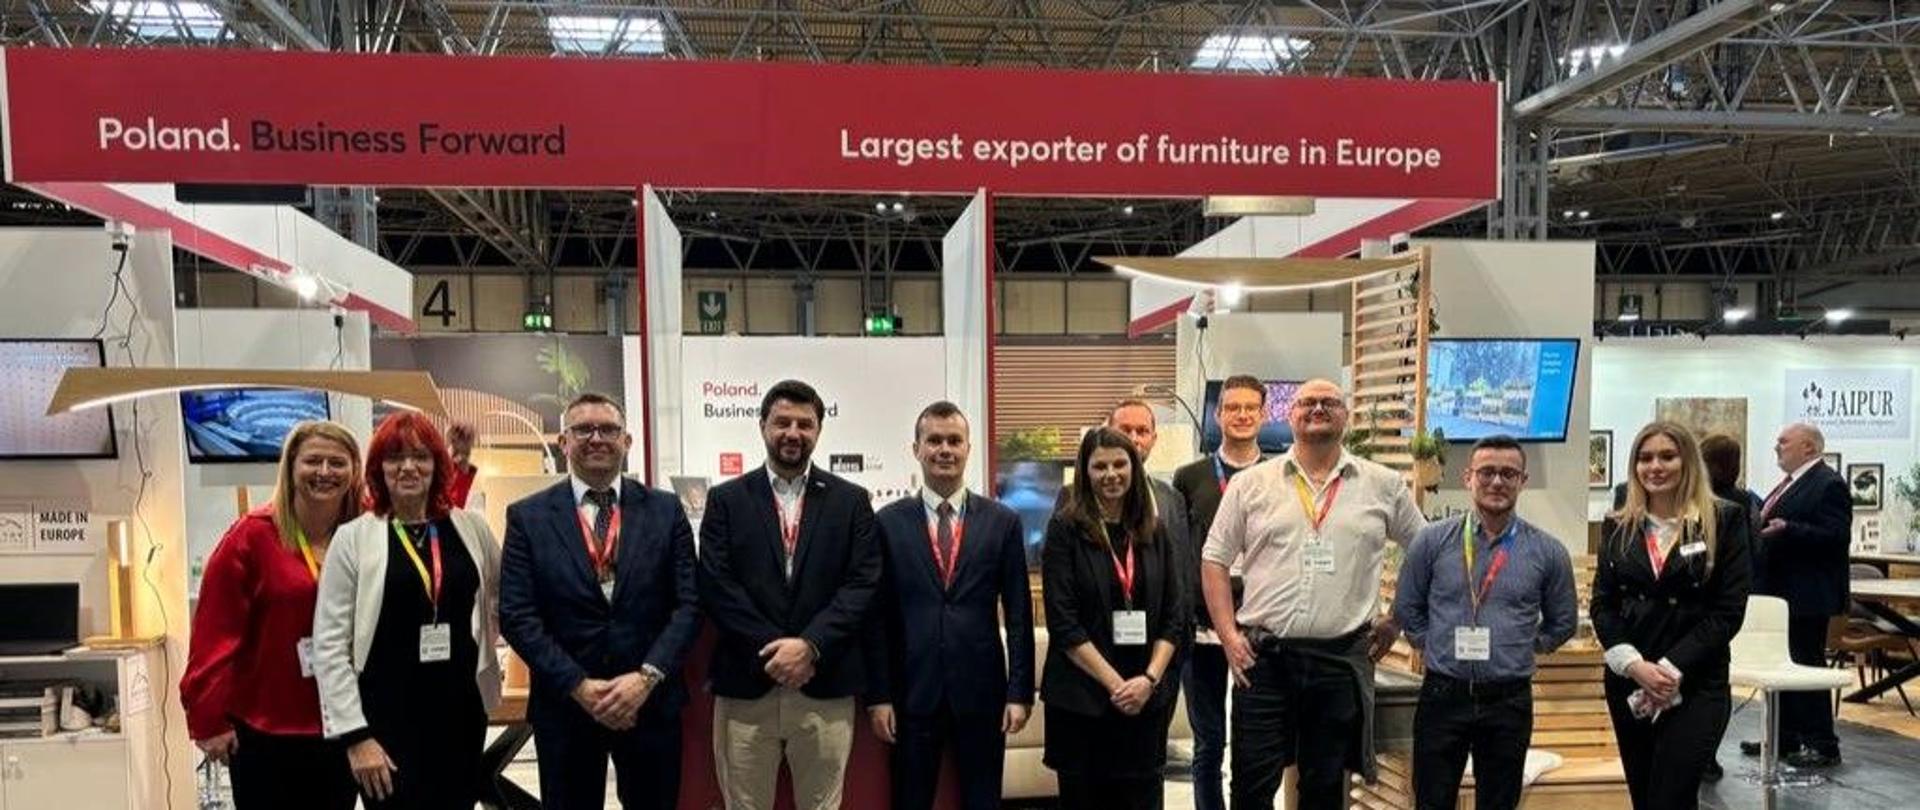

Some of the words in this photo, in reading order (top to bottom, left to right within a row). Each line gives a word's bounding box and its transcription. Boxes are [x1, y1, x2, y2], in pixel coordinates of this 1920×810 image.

[99, 117, 241, 151] Poland.
[250, 119, 407, 154] Business
[418, 122, 566, 156] Forward
[841, 129, 963, 167] Largest
[972, 135, 1108, 168] exporter
[1116, 134, 1149, 163] of
[1156, 134, 1290, 165] furniture
[1300, 138, 1326, 165] in
[1336, 138, 1441, 174] Europe
[423, 280, 456, 327] 4
[702, 381, 762, 397] Poland.
[1827, 390, 1894, 417] JAIPUR
[40, 510, 72, 523] MADE
[75, 510, 88, 523] IN
[40, 528, 86, 541] EUROPE
